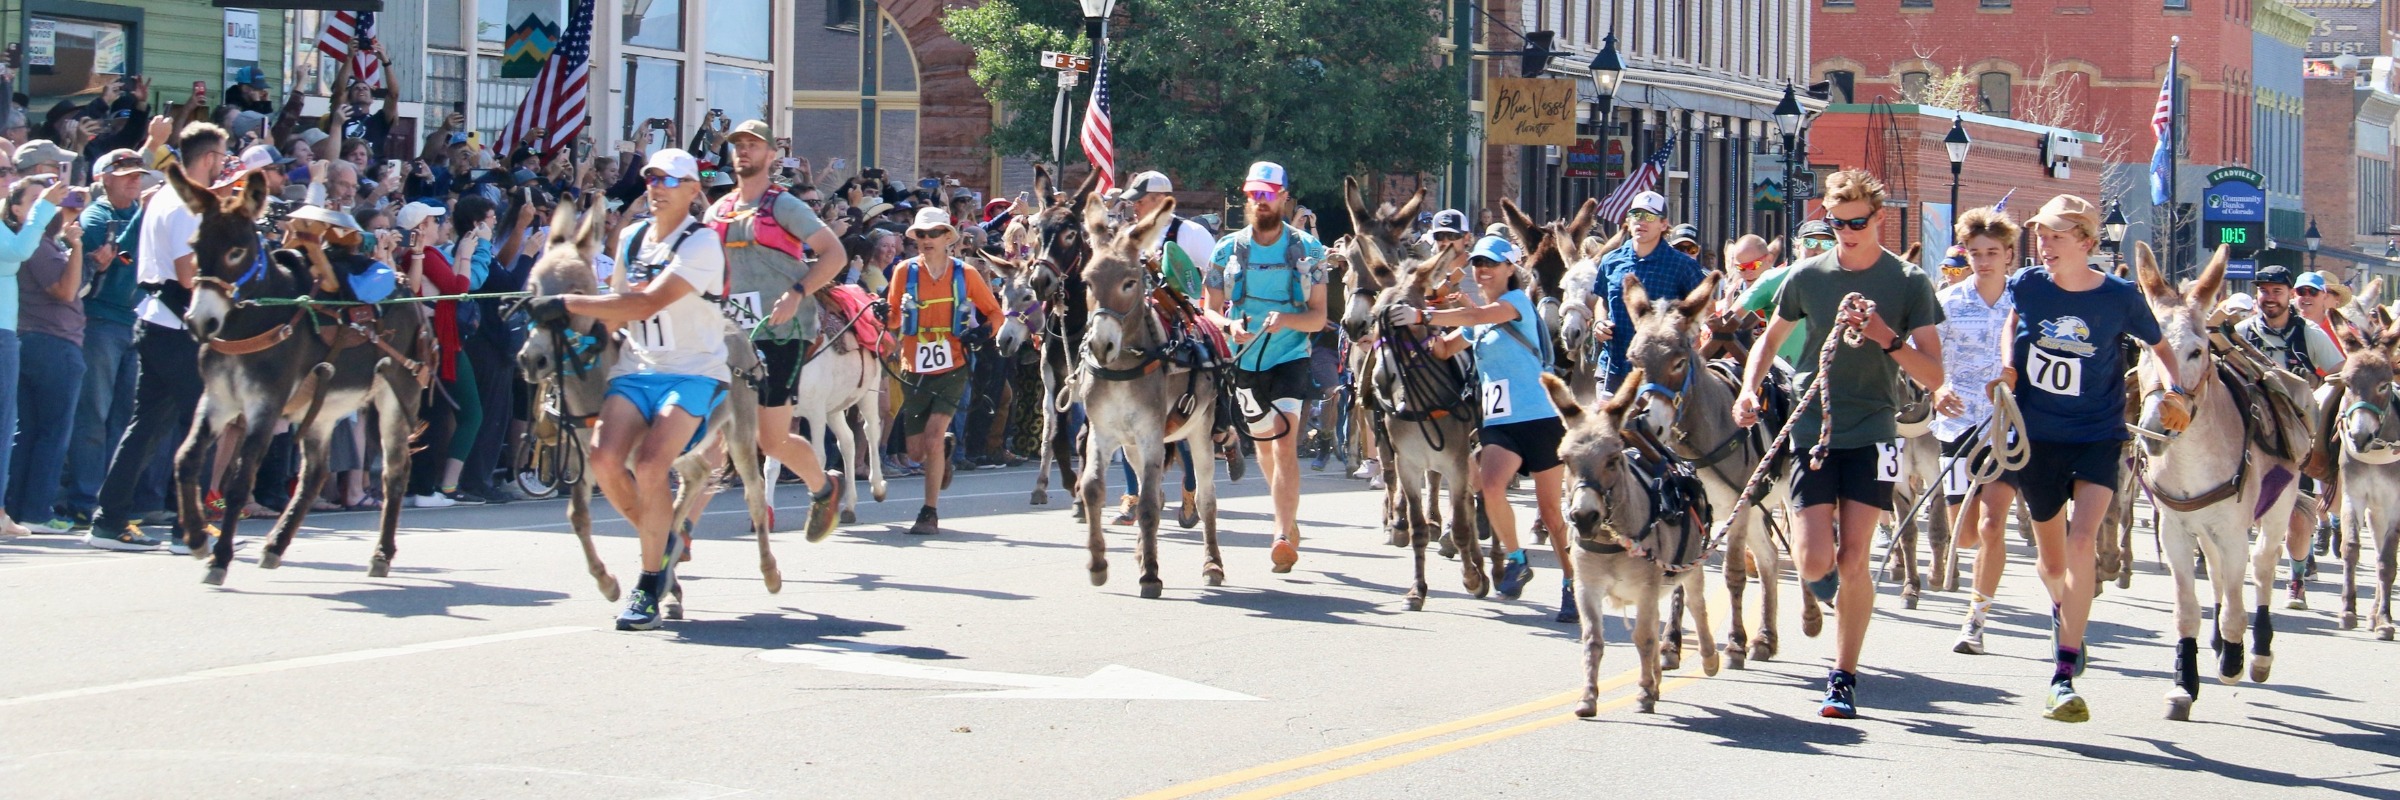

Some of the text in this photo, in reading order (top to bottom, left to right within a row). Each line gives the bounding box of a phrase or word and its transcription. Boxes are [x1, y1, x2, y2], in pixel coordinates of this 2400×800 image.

[234, 22, 257, 40] DolEx
[2321, 42, 2368, 53] BEST.
[1491, 85, 1573, 124] Blue Vessel
[2213, 169, 2256, 181] LEADVILLE
[2222, 194, 2262, 204] Community
[2221, 228, 2246, 243] 10:15
[640, 315, 664, 347] 11
[920, 345, 946, 369] 26
[2036, 353, 2072, 391] 70
[1485, 385, 1504, 416] 12
